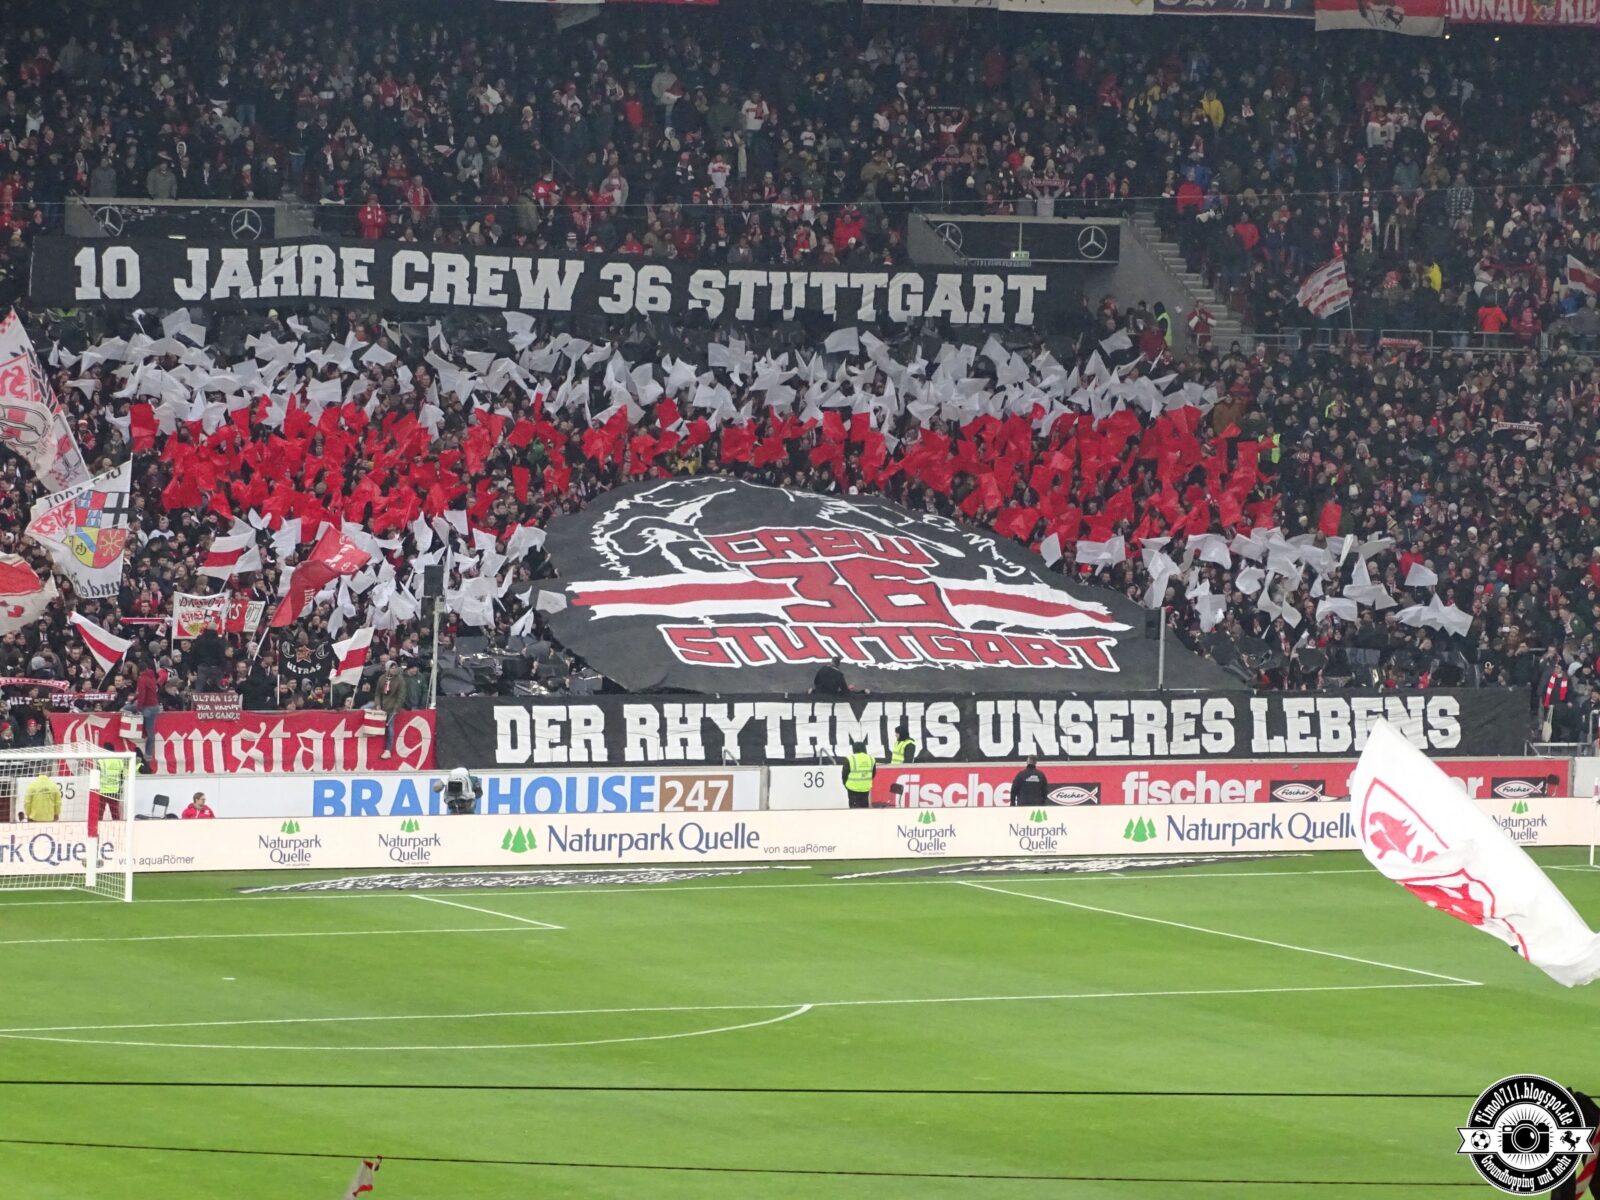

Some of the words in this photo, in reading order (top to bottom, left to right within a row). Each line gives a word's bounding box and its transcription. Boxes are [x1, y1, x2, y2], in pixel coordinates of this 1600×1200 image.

[1559, 0, 1600, 24] RIE
[74, 246, 141, 300] 10
[173, 245, 376, 300] JAHRE
[390, 250, 585, 311] CREW
[598, 262, 673, 315] 36
[688, 268, 1047, 326] STUTTGART
[703, 528, 938, 568] CREW
[748, 558, 960, 630] 36
[656, 622, 1122, 673] STUTTGART
[286, 661, 322, 675] ULTRAS
[192, 694, 221, 702] ULTRA
[223, 694, 239, 703] IST
[493, 704, 608, 764] DER
[623, 701, 961, 762] RHYTHMUS
[976, 698, 1236, 758] UNSERES
[1249, 695, 1462, 753] LEBENS
[803, 771, 825, 789] 36
[1122, 771, 1262, 805] fischer
[312, 774, 656, 817] BRAIHOUSE
[663, 778, 731, 812] 247
[895, 773, 1013, 808] fische
[1055, 791, 1086, 800] fischer
[1280, 786, 1312, 799] fischer
[1501, 784, 1532, 794] fischer
[1166, 812, 1284, 847] Naturpark
[1491, 813, 1548, 830] Naturpark
[896, 824, 957, 840] Naturpark
[1009, 823, 1068, 839] Naturpark
[258, 834, 322, 850] Naturpark
[378, 833, 441, 849] Naturpark
[548, 822, 674, 858] Naturpark
[678, 822, 760, 852] Quelle
[763, 846, 780, 855] von
[782, 841, 836, 856] aquaRömer
[907, 838, 947, 853] Quelle
[1019, 836, 1058, 852] Quelle
[29, 833, 115, 866] Quee
[269, 848, 312, 865] Quelle
[389, 847, 431, 863] Quelle
[139, 854, 195, 867] aquaRömer
